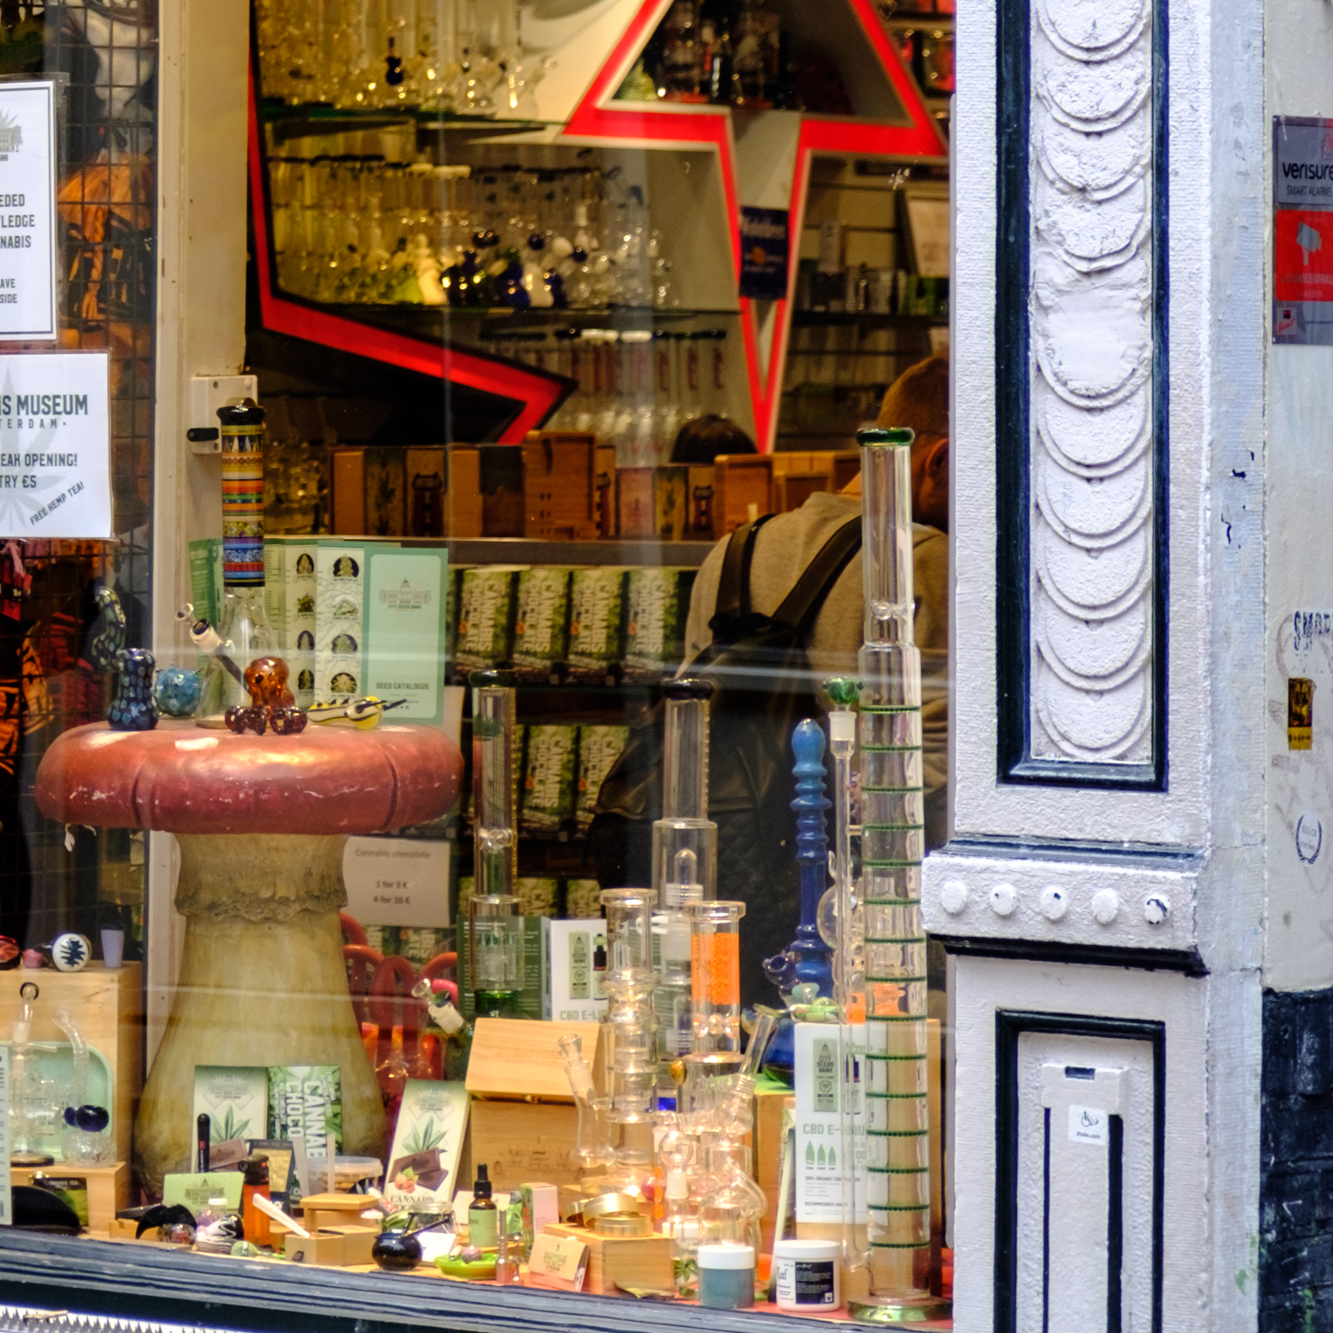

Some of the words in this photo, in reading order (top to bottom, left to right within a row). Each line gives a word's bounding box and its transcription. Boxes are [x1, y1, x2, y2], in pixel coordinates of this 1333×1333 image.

[1286, 185, 1306, 196] SMART
[1307, 186, 1332, 197] ALARMS
[16, 394, 89, 416] MUSEUM
[24, 453, 78, 467] OPENING!
[22, 475, 37, 488] €5
[29, 507, 48, 526] FREE
[47, 492, 67, 512] HEMP
[67, 481, 85, 498] TEA!
[536, 580, 555, 652] CANNABIS
[591, 581, 609, 653] CANNABIS
[649, 581, 666, 653] CANNABIS
[375, 682, 392, 690] SEED
[393, 682, 430, 690] CATALOGUE
[560, 1010, 580, 1021] CBD
[803, 1123, 825, 1135] CBD
